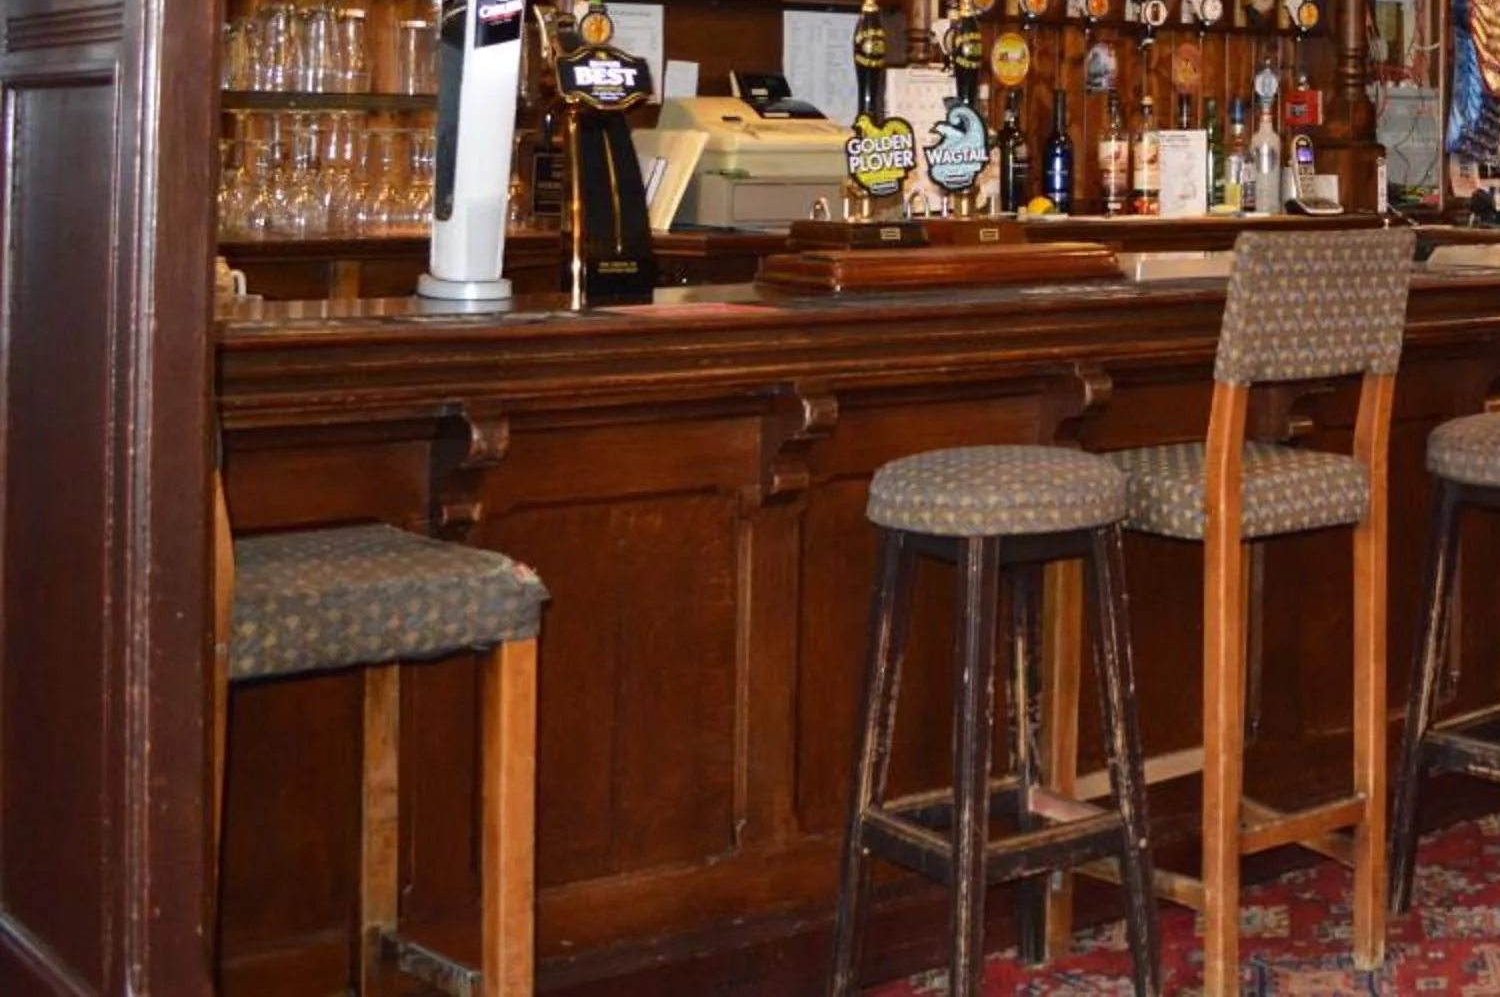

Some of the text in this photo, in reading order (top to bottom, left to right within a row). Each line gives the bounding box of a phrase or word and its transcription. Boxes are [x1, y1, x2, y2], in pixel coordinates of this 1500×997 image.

[573, 66, 637, 86] BEST
[848, 134, 912, 154] GOLDEN
[850, 150, 914, 173] PLOVER
[926, 147, 989, 165] WAGTAIL
